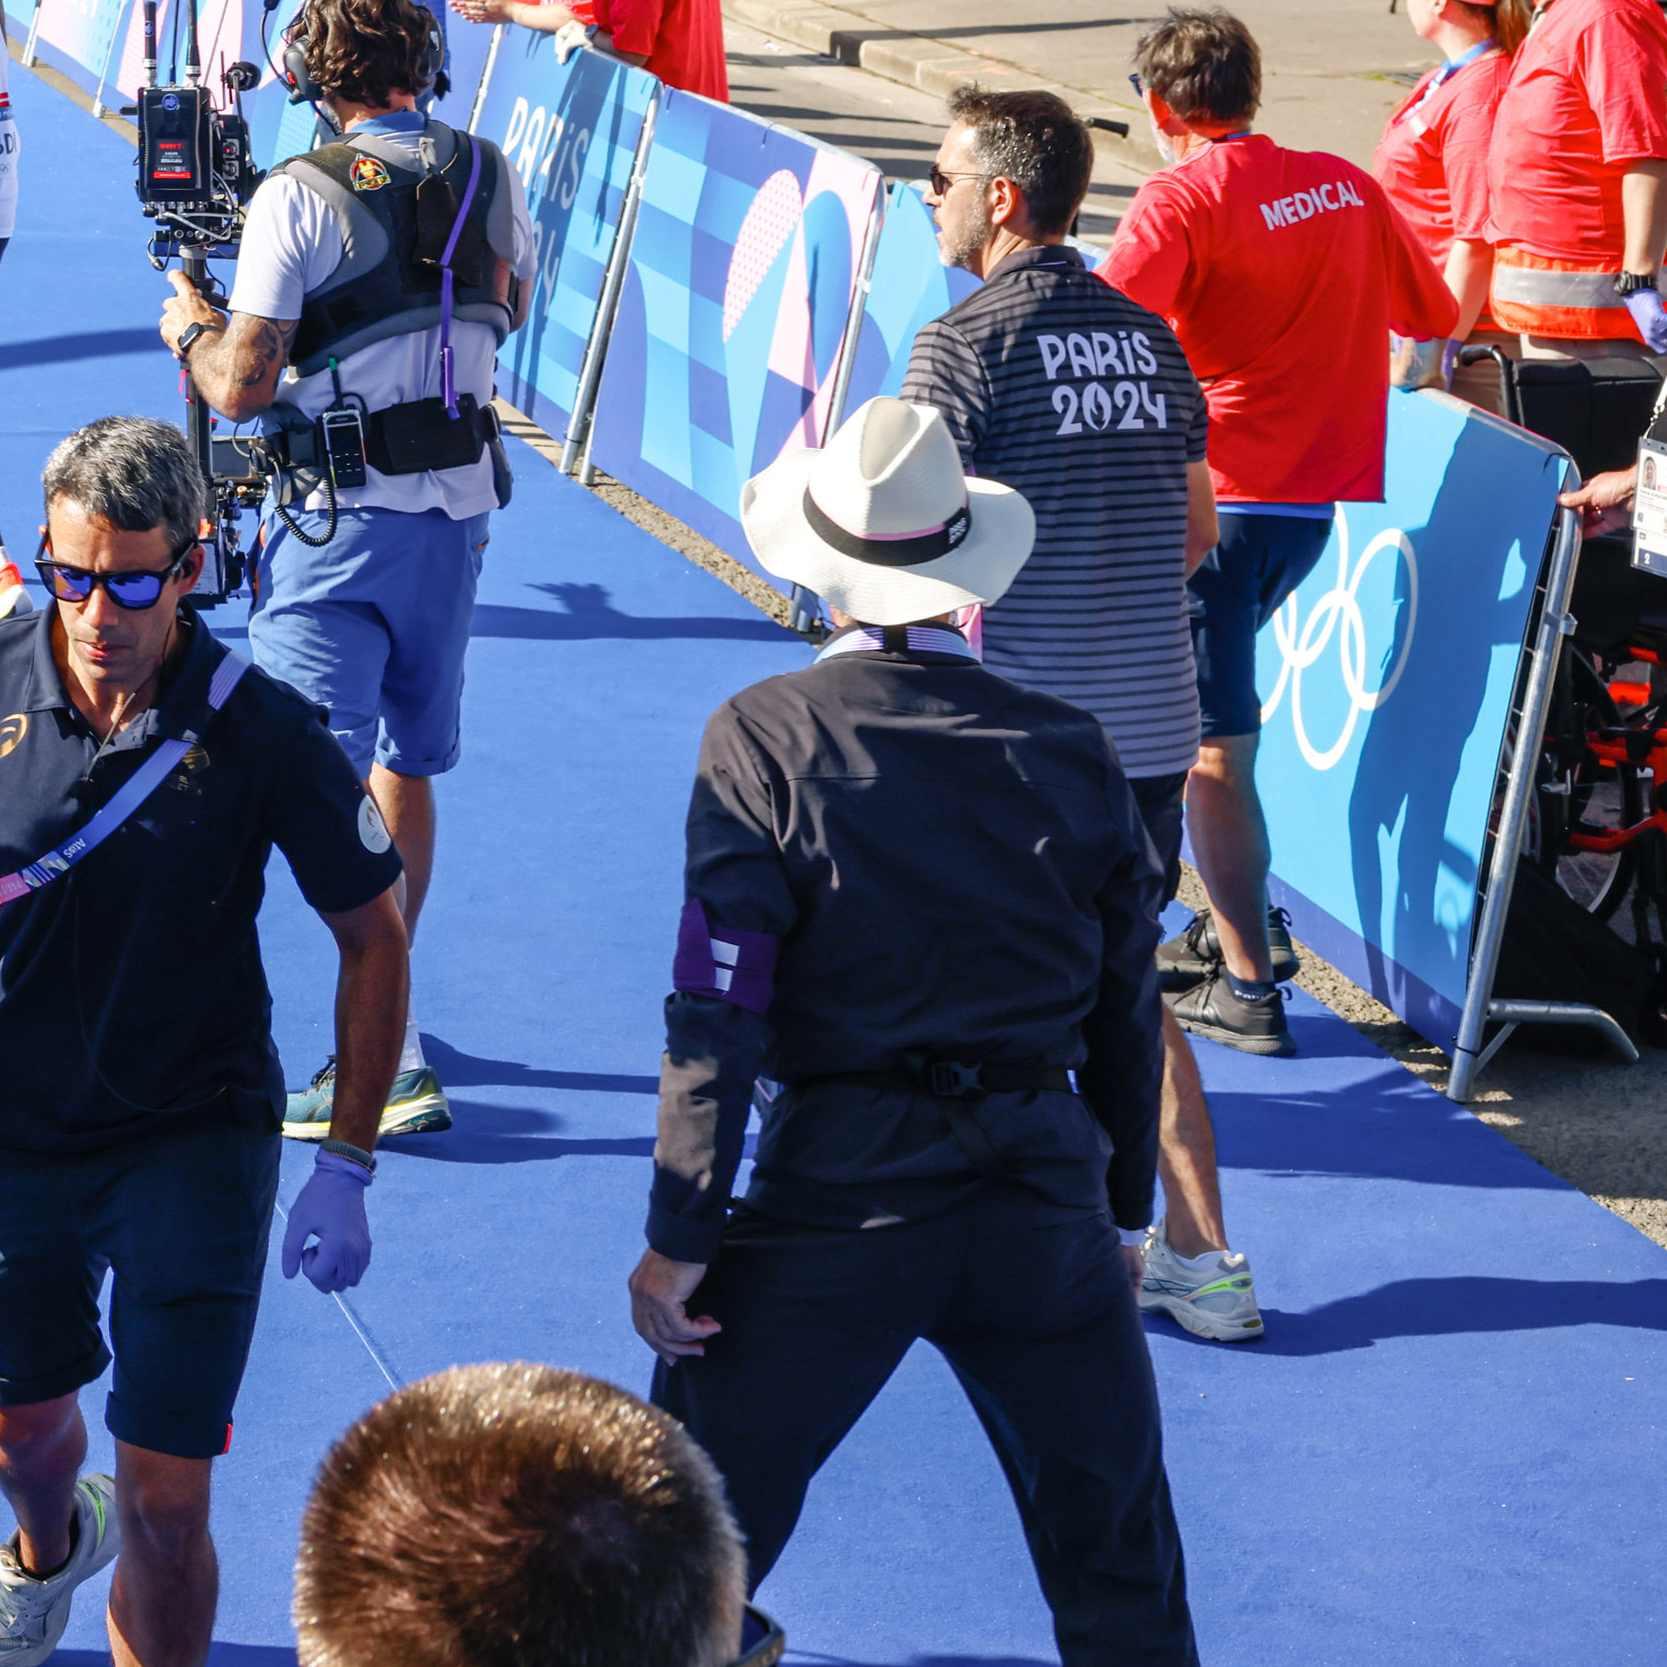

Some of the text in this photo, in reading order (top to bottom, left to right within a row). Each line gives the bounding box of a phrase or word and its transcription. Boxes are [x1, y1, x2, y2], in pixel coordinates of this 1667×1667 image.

[1259, 181, 1364, 230] MEDICAL
[1051, 381, 1167, 435] 2024
[1644, 553, 1651, 564] 2
